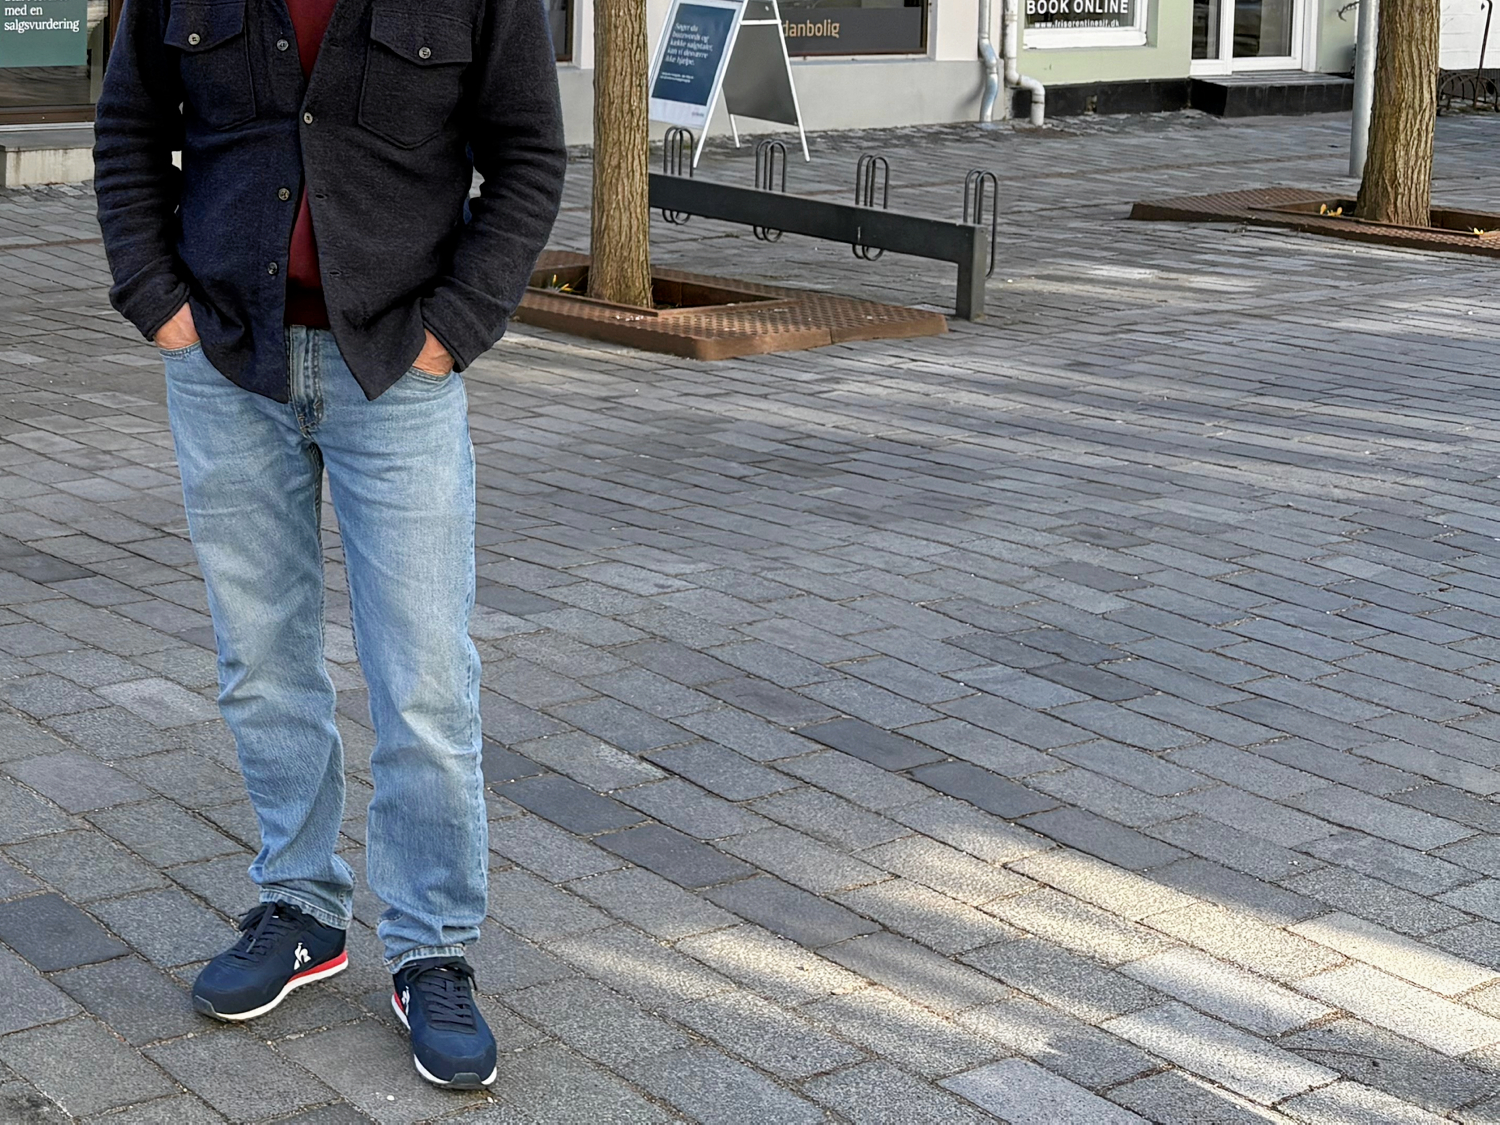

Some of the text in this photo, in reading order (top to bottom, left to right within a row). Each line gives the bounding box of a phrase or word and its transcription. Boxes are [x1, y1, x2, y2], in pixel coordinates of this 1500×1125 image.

[4, 3, 43, 16] med en
[4, 17, 80, 34] salgsvurdering
